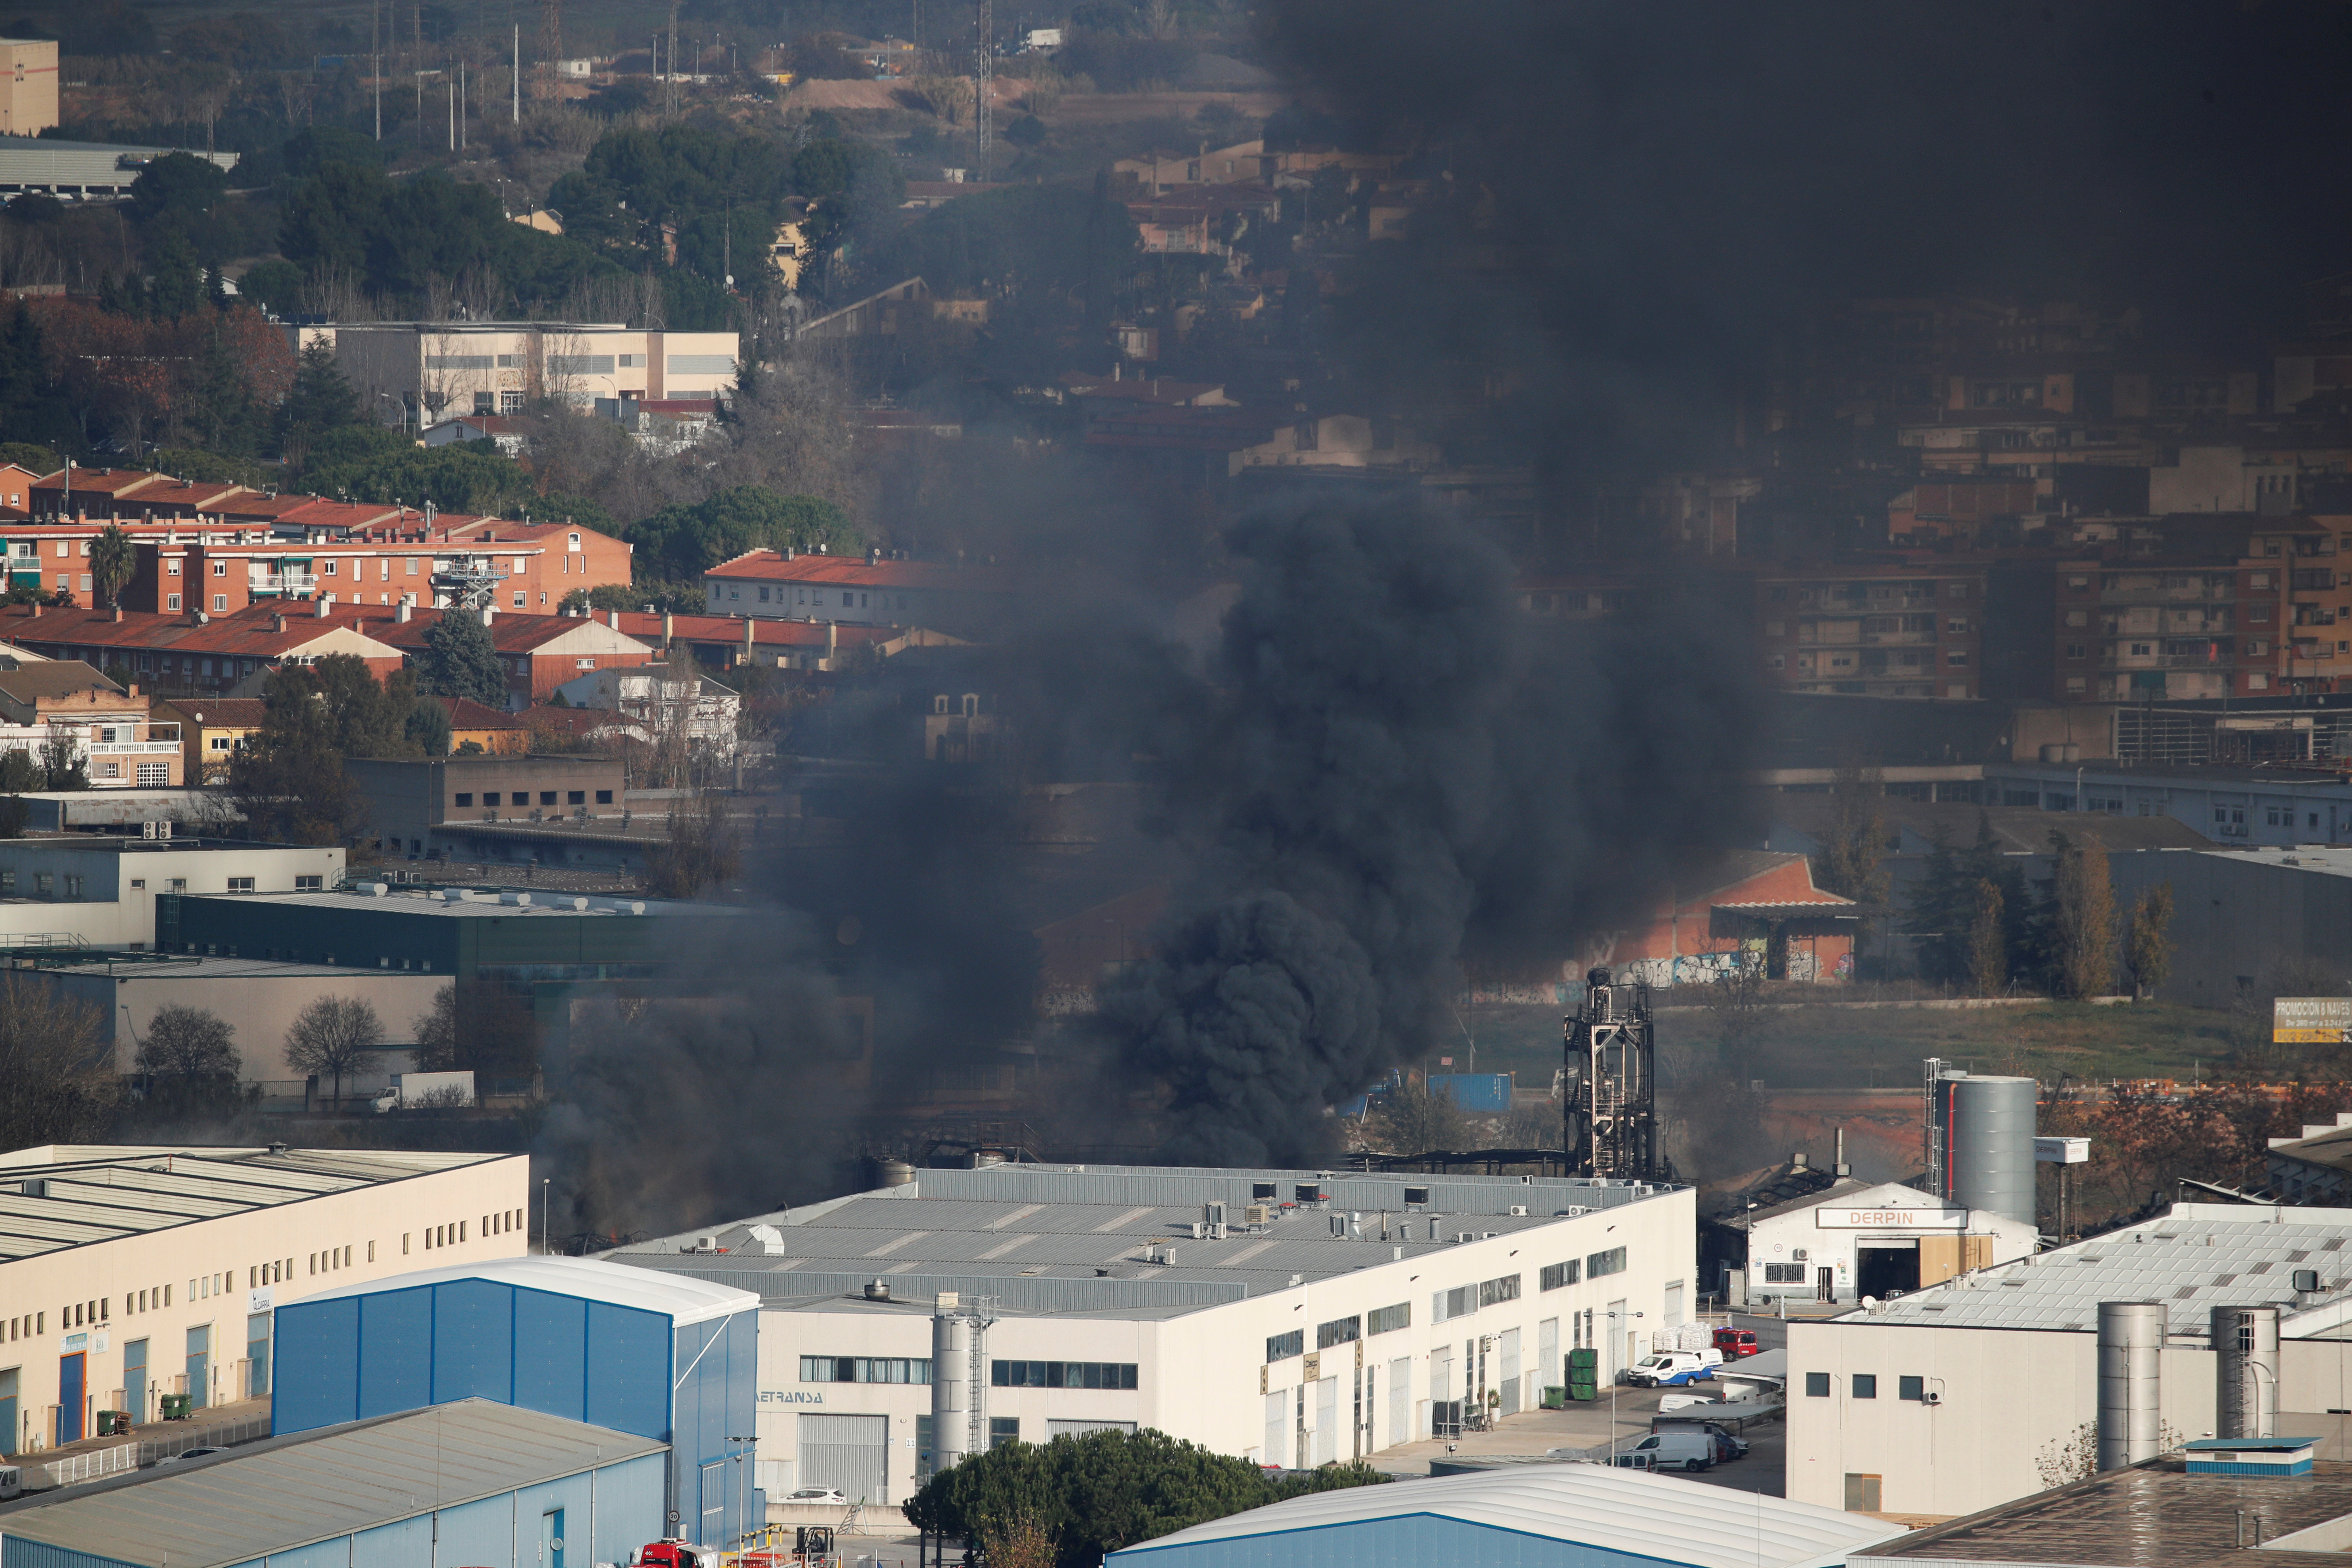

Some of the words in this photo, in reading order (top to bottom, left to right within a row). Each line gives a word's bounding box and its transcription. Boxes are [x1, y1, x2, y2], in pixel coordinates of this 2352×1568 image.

[2276, 998, 2320, 1016] PROMOCIÓN
[2327, 1002, 2350, 1016] NAVES
[2036, 1146, 2057, 1155] DERPIN
[1850, 1212, 1913, 1224] DERPIN
[254, 1299, 270, 1311] ALCARRIA
